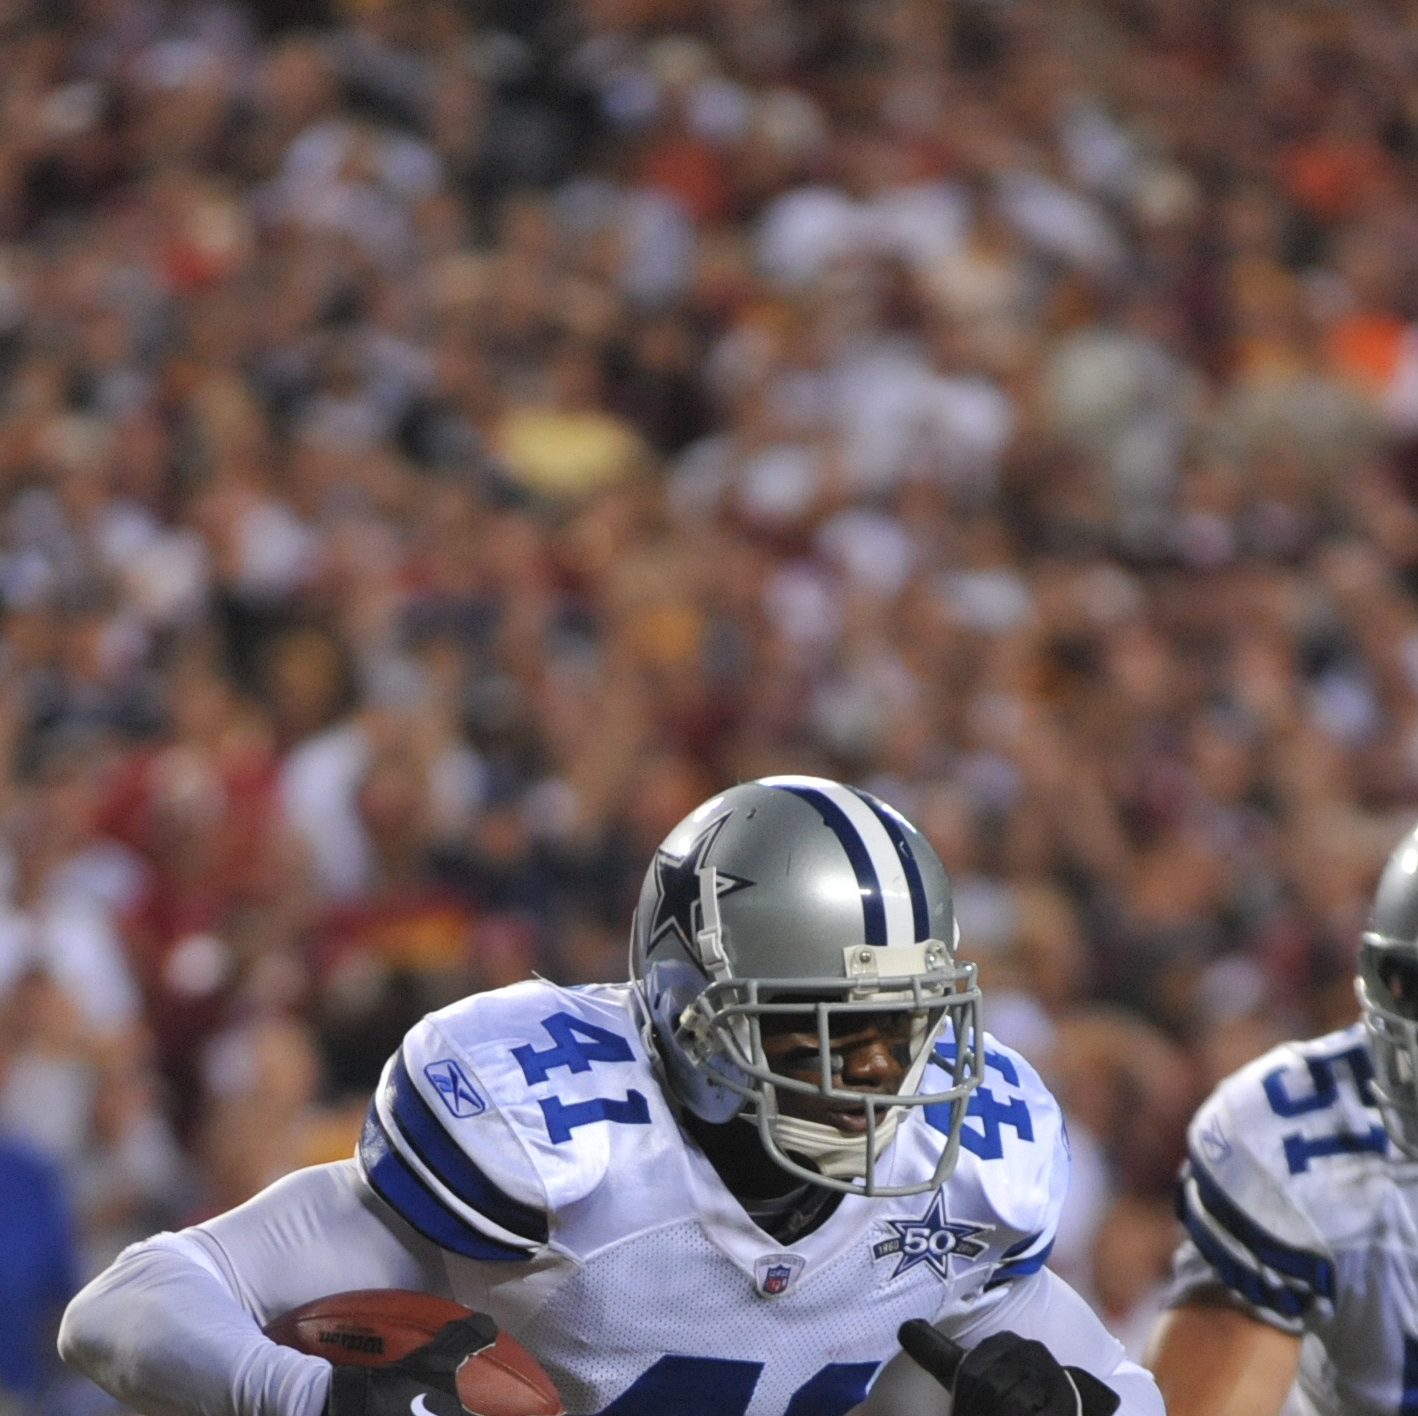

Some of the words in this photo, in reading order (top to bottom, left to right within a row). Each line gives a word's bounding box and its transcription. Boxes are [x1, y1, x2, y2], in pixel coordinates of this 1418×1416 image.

[510, 1012, 652, 1144] 41
[922, 1042, 1035, 1160] 41
[1263, 1043, 1389, 1175] 51
[903, 1227, 956, 1255] 50
